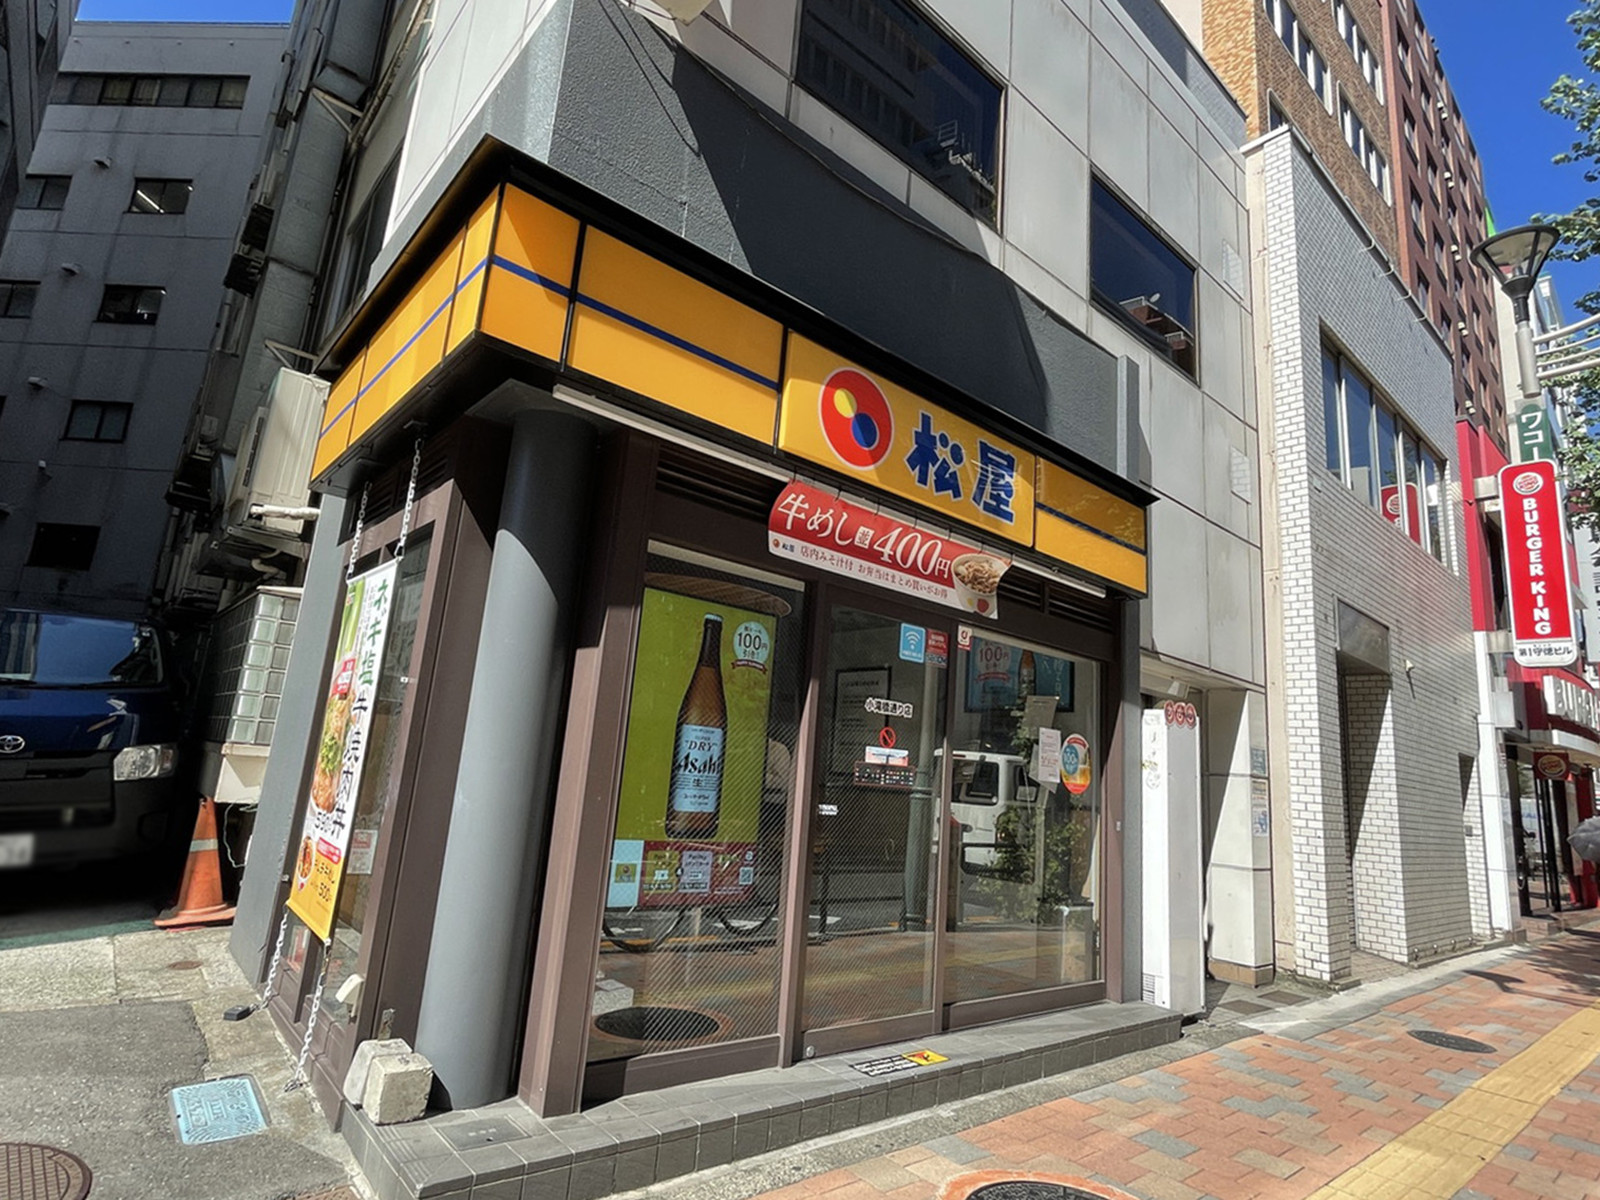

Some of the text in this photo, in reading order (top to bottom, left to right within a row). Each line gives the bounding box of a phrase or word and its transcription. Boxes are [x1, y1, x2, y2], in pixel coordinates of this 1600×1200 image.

[904, 409, 1018, 525] 松屋
[1521, 497, 1545, 577] BURGER
[1530, 581, 1552, 635] KING
[675, 751, 722, 776] Asahi
